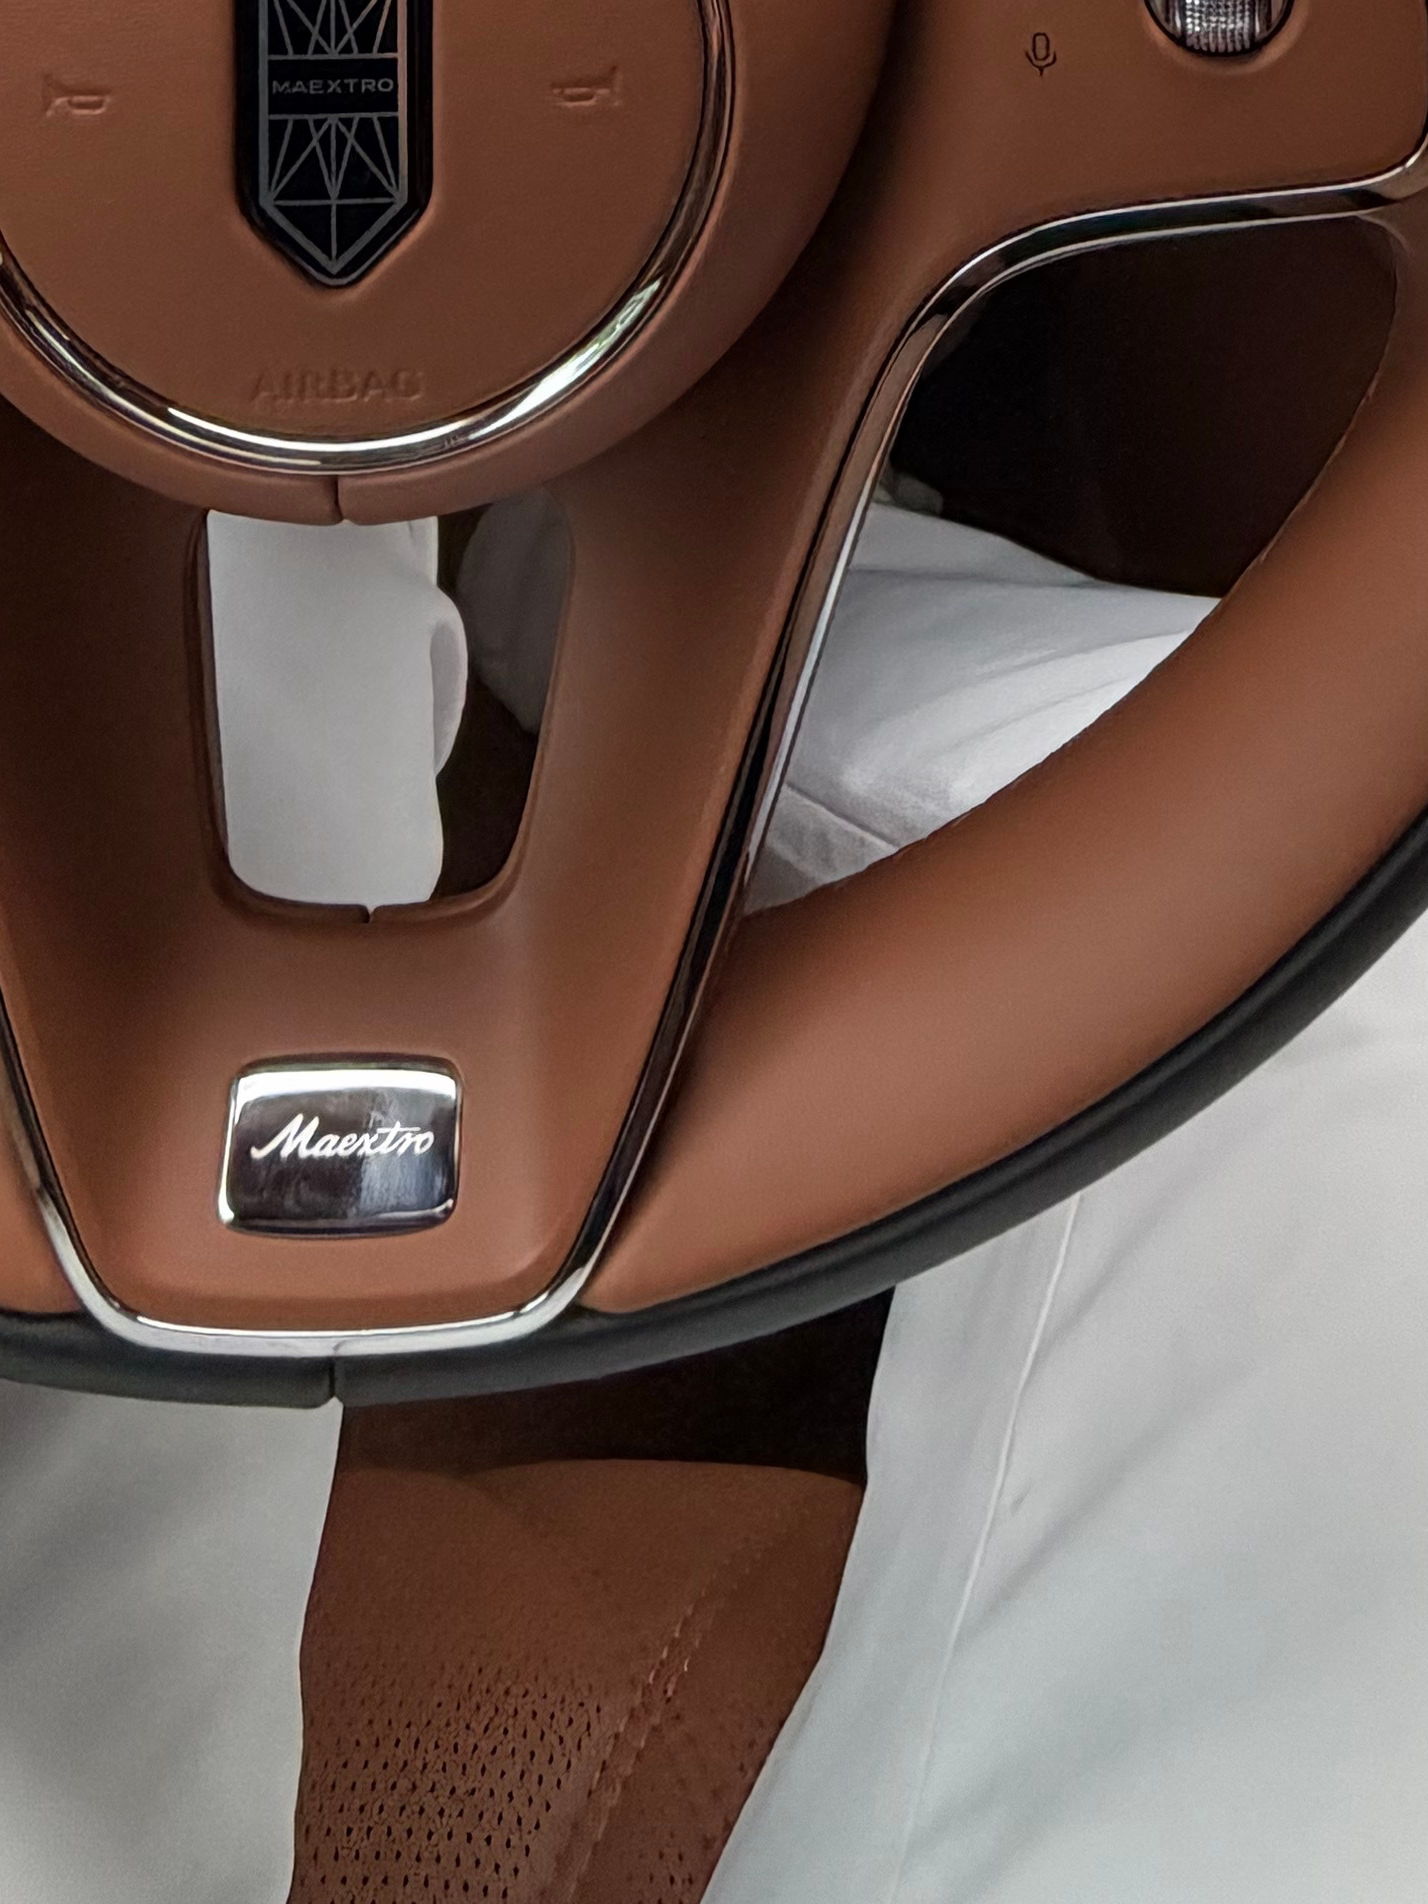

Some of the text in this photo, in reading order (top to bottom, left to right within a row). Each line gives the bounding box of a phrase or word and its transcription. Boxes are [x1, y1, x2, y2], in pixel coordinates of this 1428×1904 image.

[272, 78, 394, 96] MAEXTRO
[248, 368, 424, 406] AIRBAG
[250, 1113, 435, 1159] Maextro
